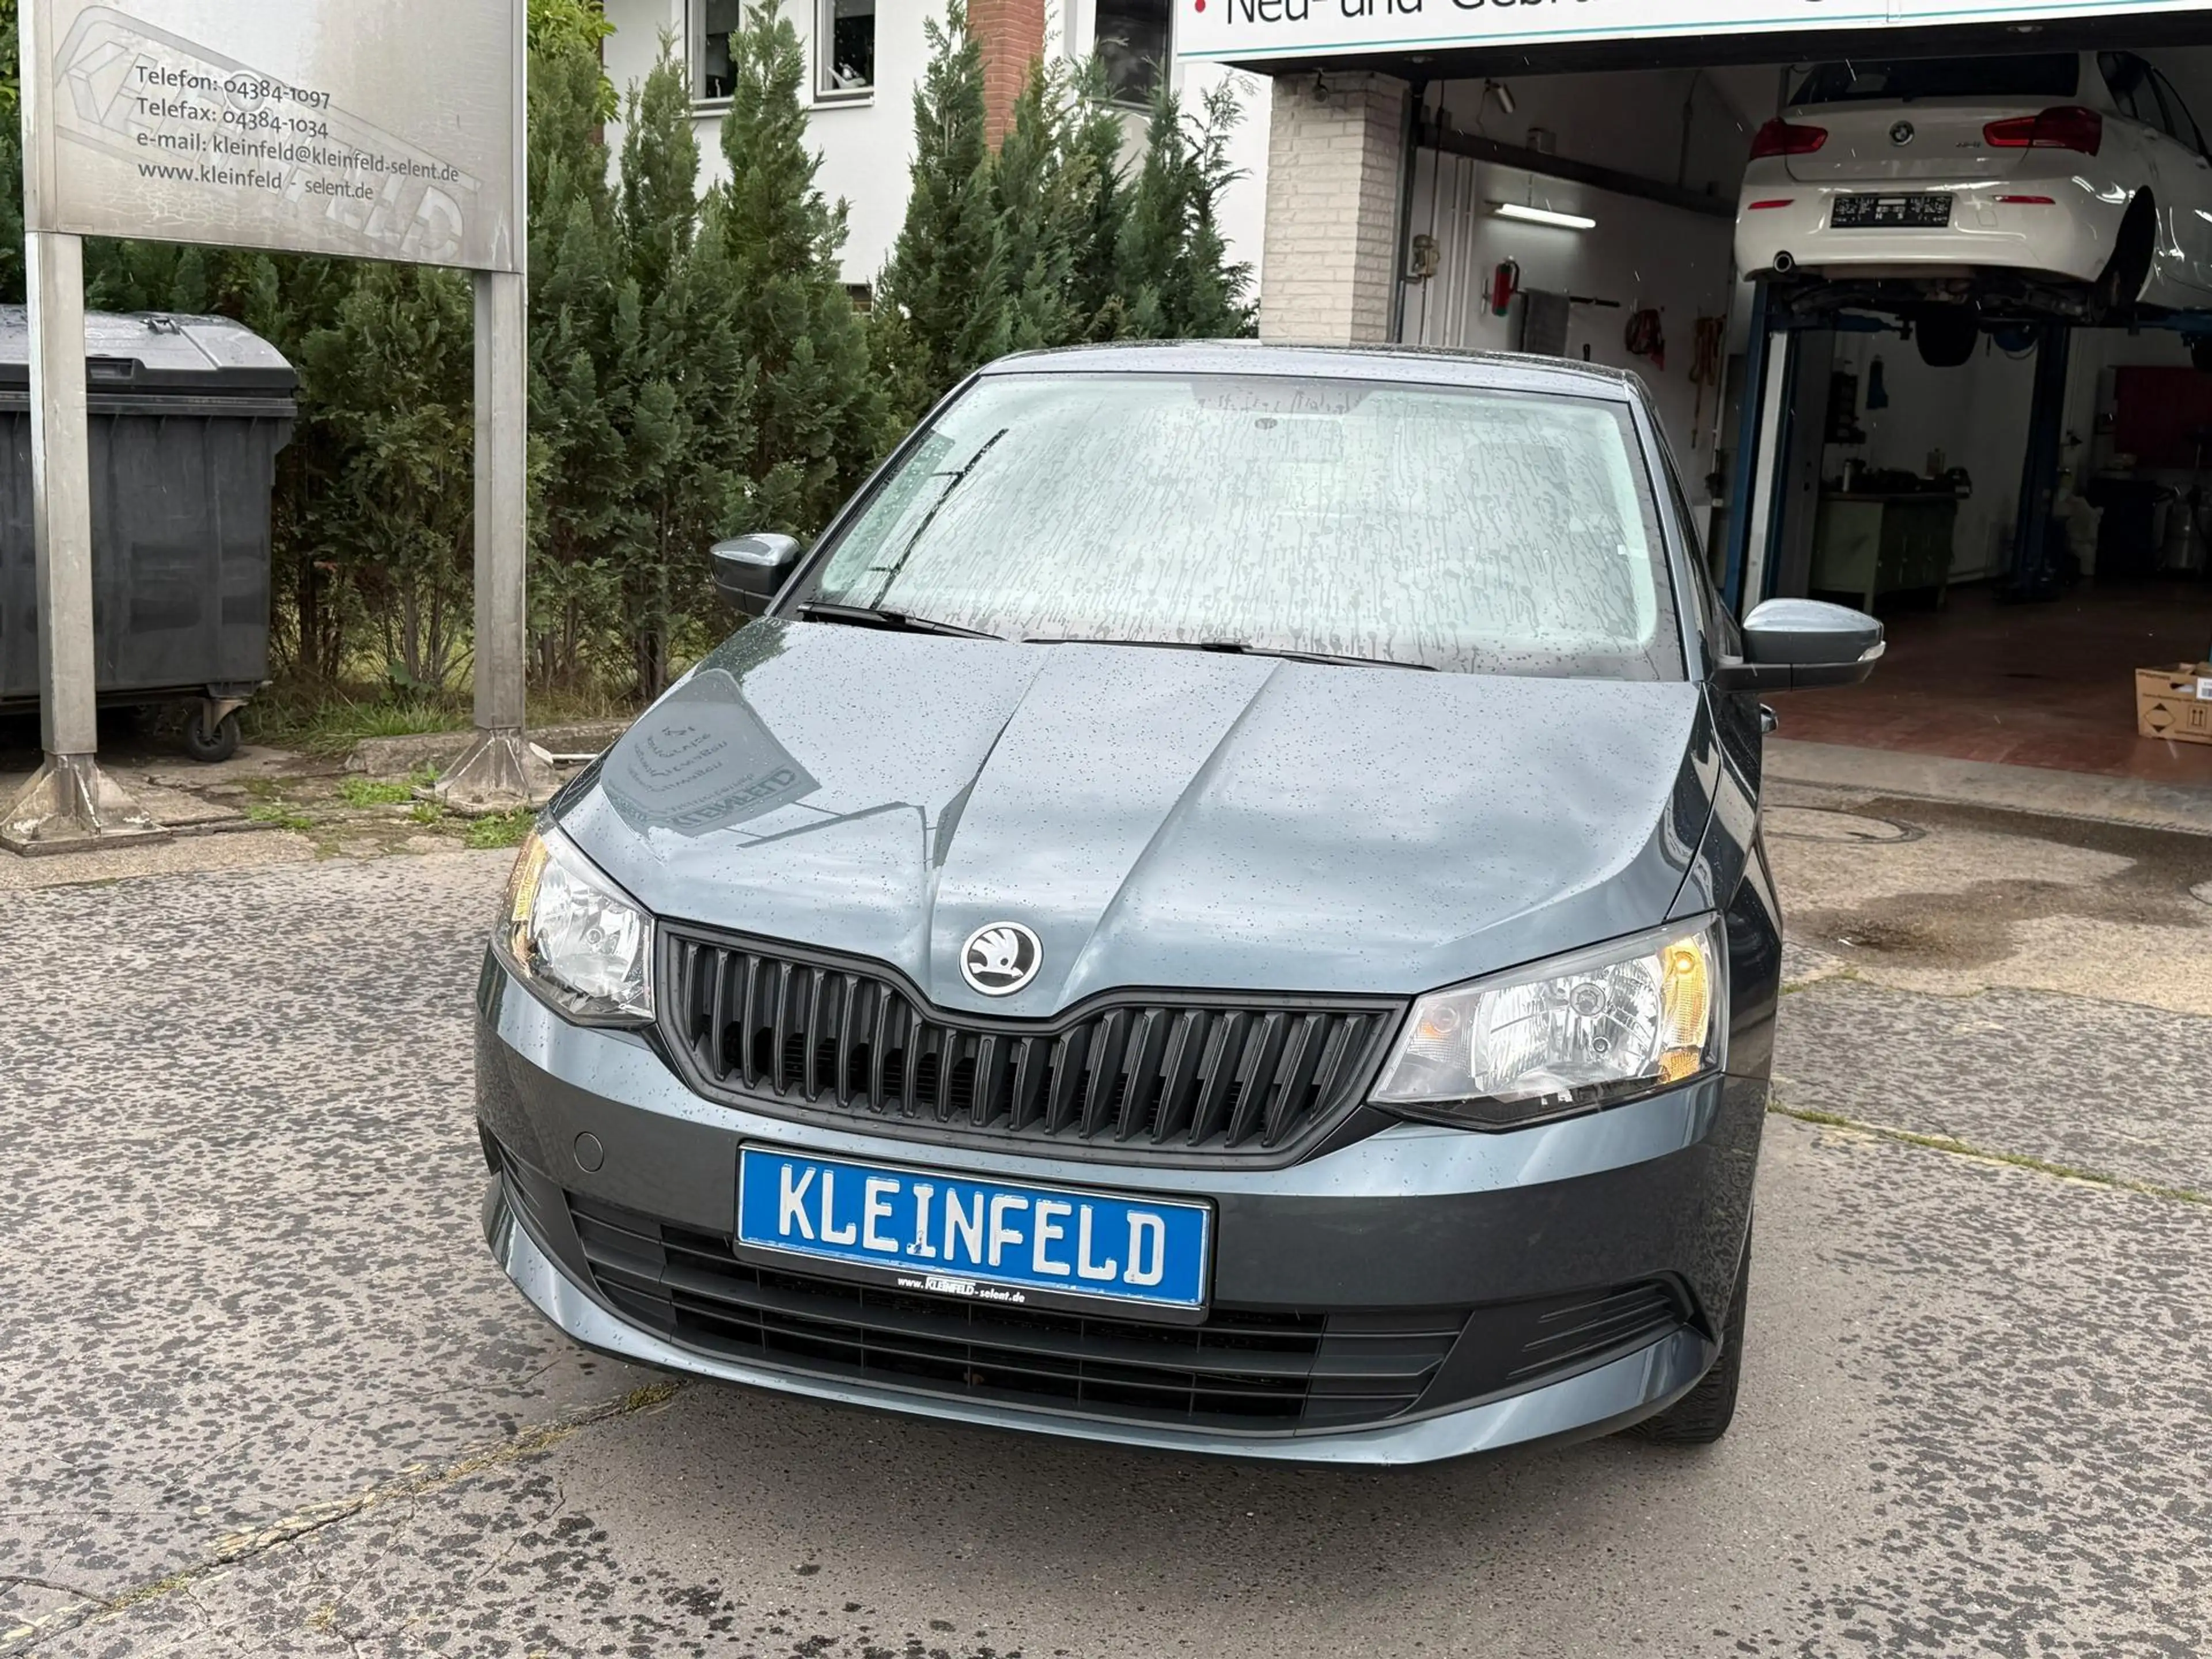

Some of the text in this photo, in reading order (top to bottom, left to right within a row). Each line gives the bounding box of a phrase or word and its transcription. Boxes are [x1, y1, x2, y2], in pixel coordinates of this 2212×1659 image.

[135, 66, 331, 109] Telefon: 04384-1097
[136, 97, 329, 139] Telefax: 04384-1034
[137, 132, 459, 182] e-mail: kleinfeld@kleinfeld-selent.de
[779, 1163, 1166, 1286] KLEINFELD
